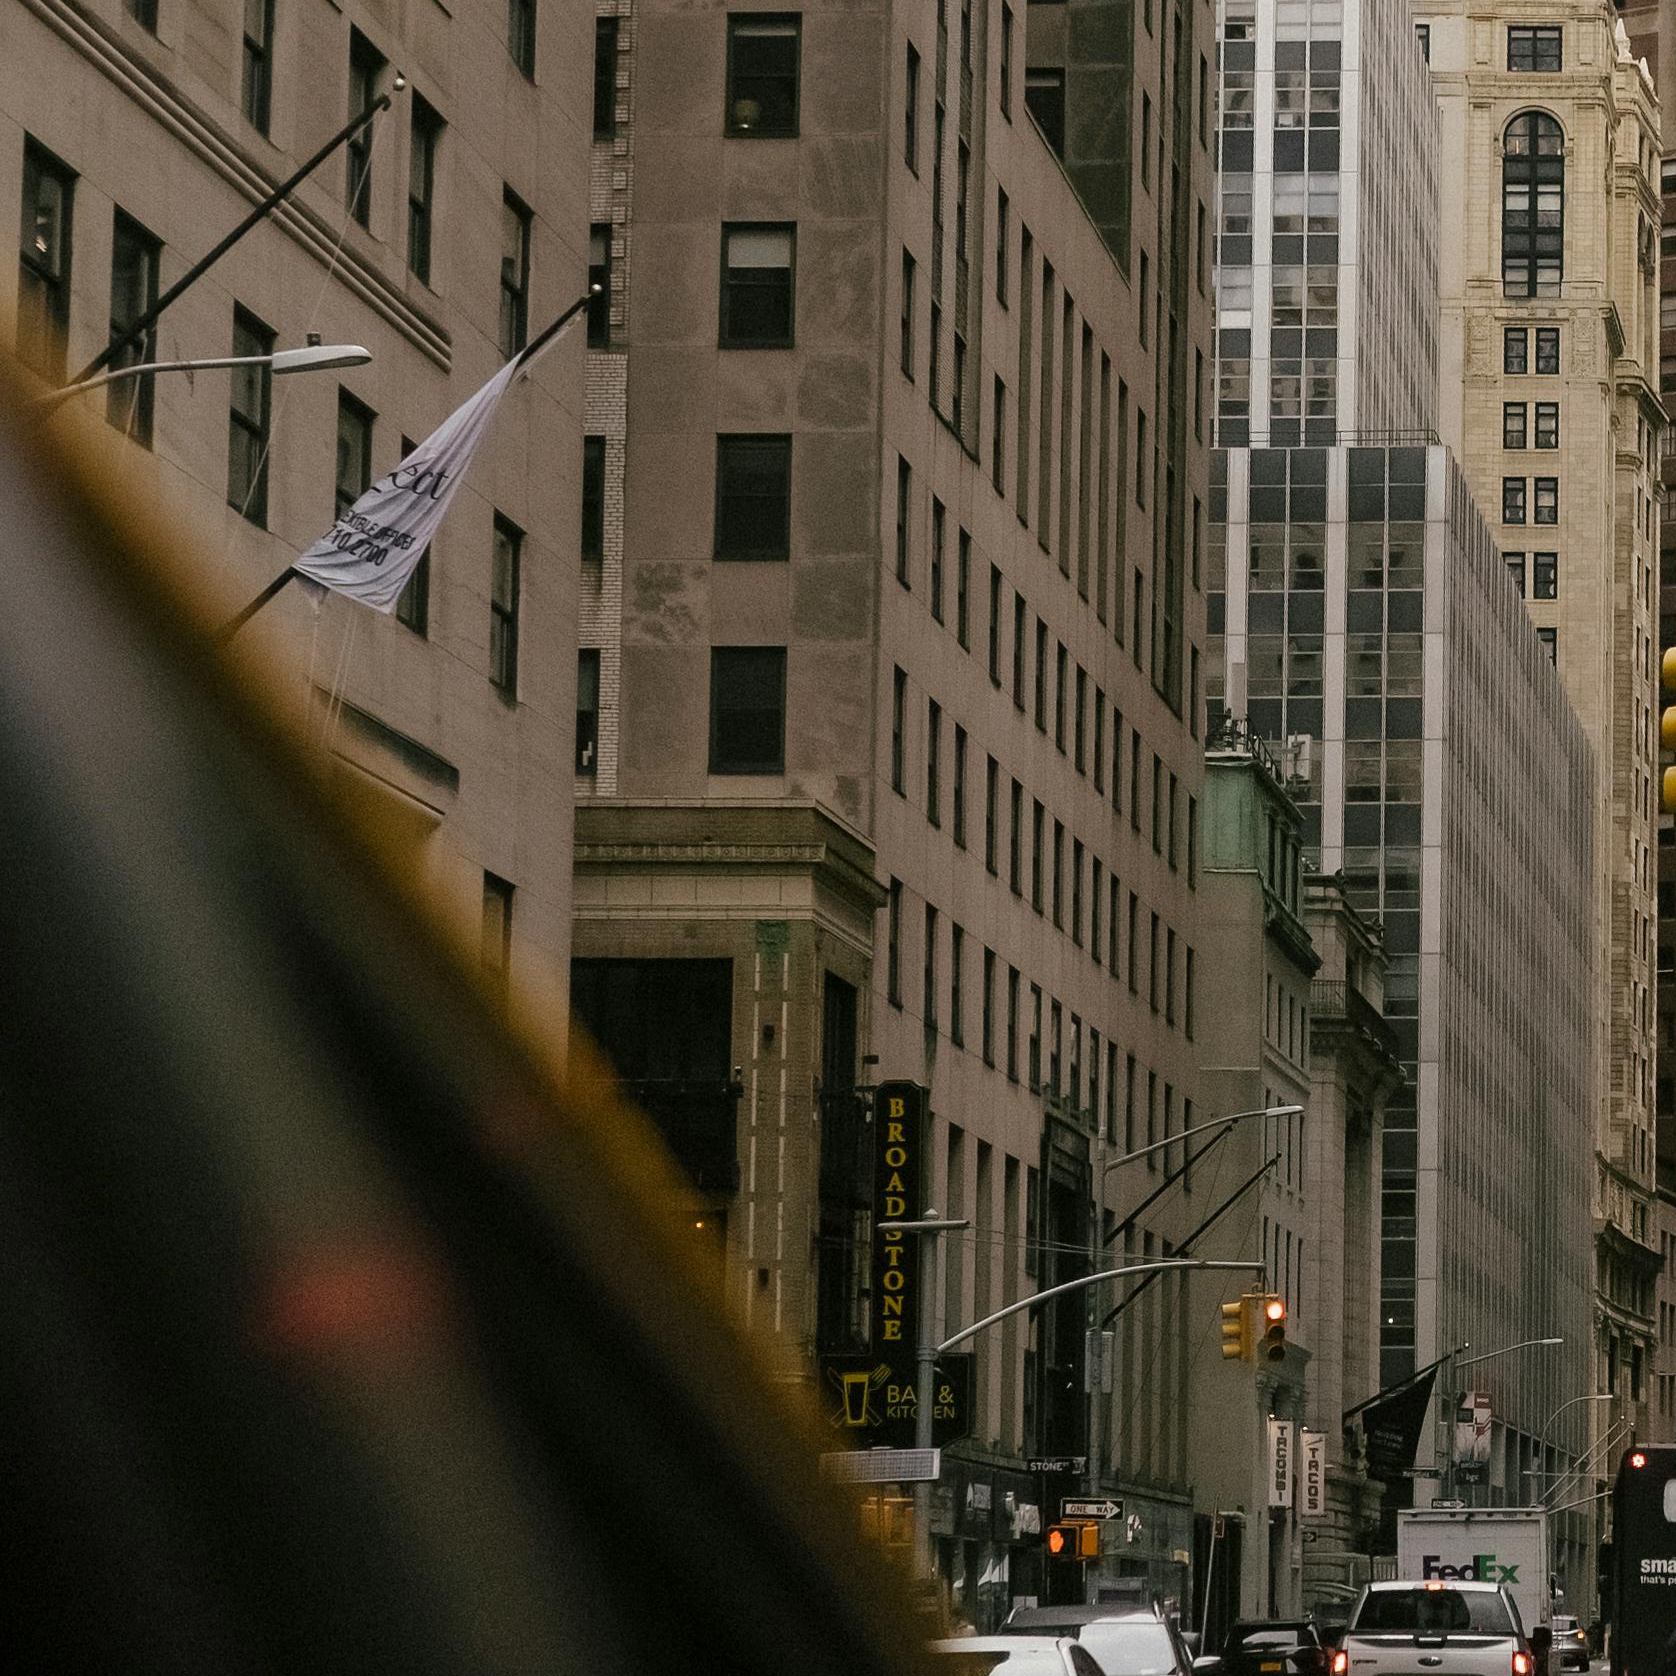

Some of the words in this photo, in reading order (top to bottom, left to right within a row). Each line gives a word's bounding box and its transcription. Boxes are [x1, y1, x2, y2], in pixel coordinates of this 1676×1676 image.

[883, 1097, 907, 1341] BROADSTONE
[887, 1385, 917, 1403] BA
[887, 1406, 955, 1419] KITCEN
[1030, 1460, 1062, 1472] STONE
[1275, 1426, 1287, 1501] TACOMBI
[1308, 1447, 1320, 1510] TACOS
[1070, 1504, 1088, 1513] ONE
[1096, 1504, 1114, 1513] WAY
[1423, 1555, 1520, 1584] FedEx
[1640, 1574, 1665, 1584] that's
